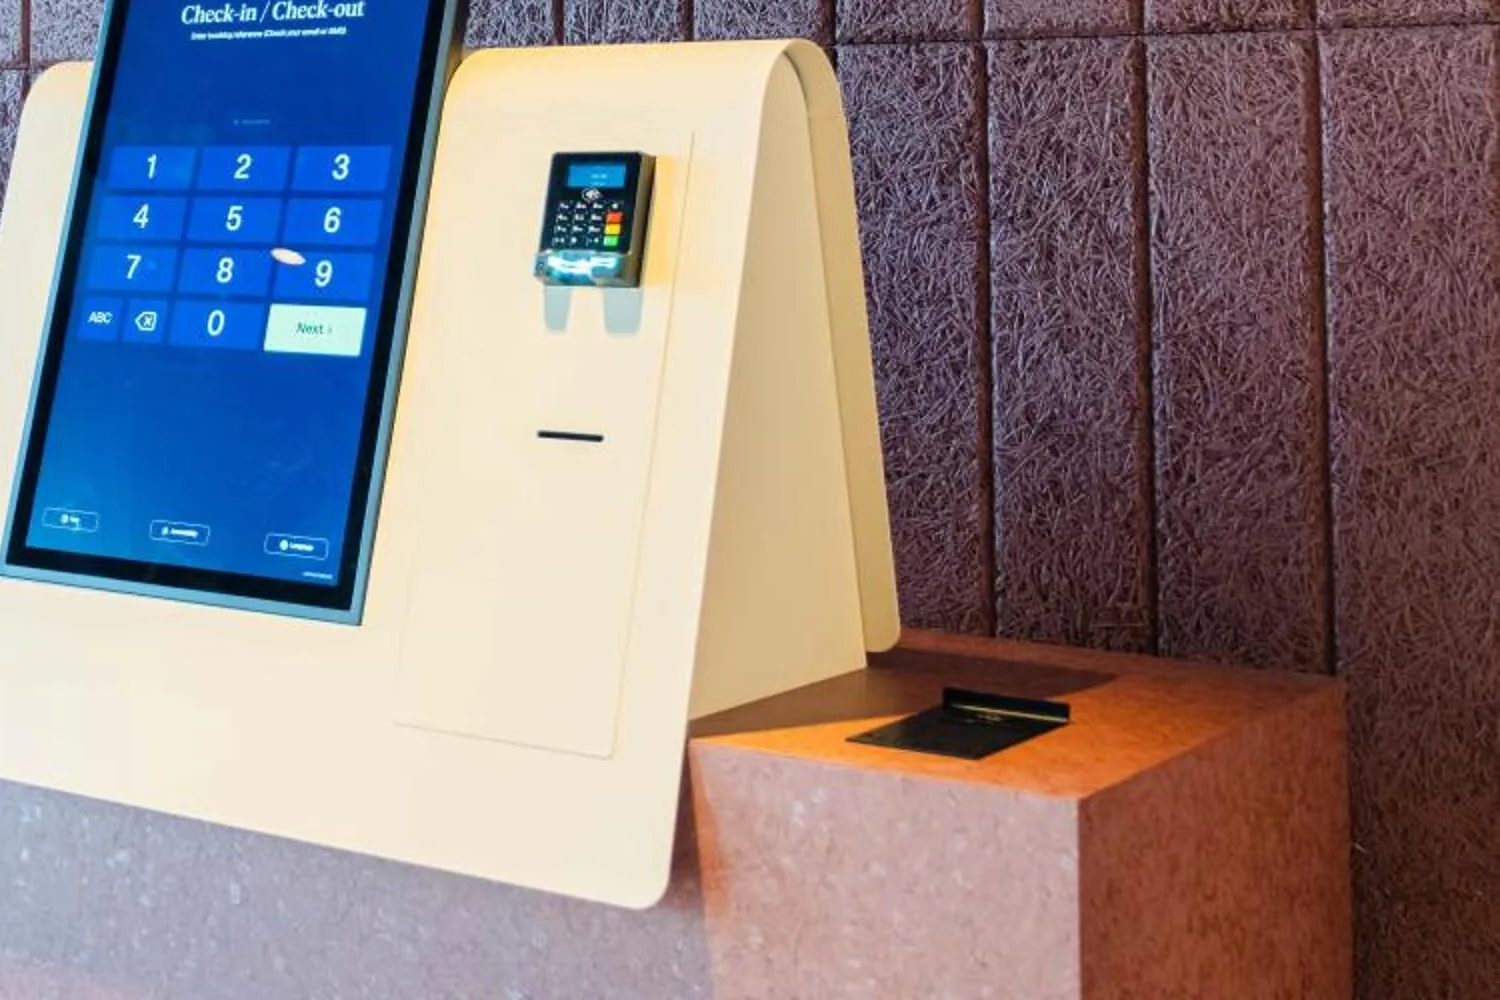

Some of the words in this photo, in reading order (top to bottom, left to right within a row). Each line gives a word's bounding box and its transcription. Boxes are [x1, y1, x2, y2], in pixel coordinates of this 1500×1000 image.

[181, 2, 258, 25] Check-in
[271, 0, 365, 22] Check-out
[146, 153, 157, 179] 1
[233, 153, 252, 180] 2
[331, 153, 350, 181] 3
[133, 203, 149, 229] 4
[225, 205, 243, 231] 5
[323, 206, 341, 233] 6
[126, 254, 142, 280] 7
[216, 256, 234, 283] 8
[315, 260, 333, 287] 9
[88, 311, 113, 324] ABC
[206, 309, 225, 337] 0
[296, 322, 325, 335] Next
